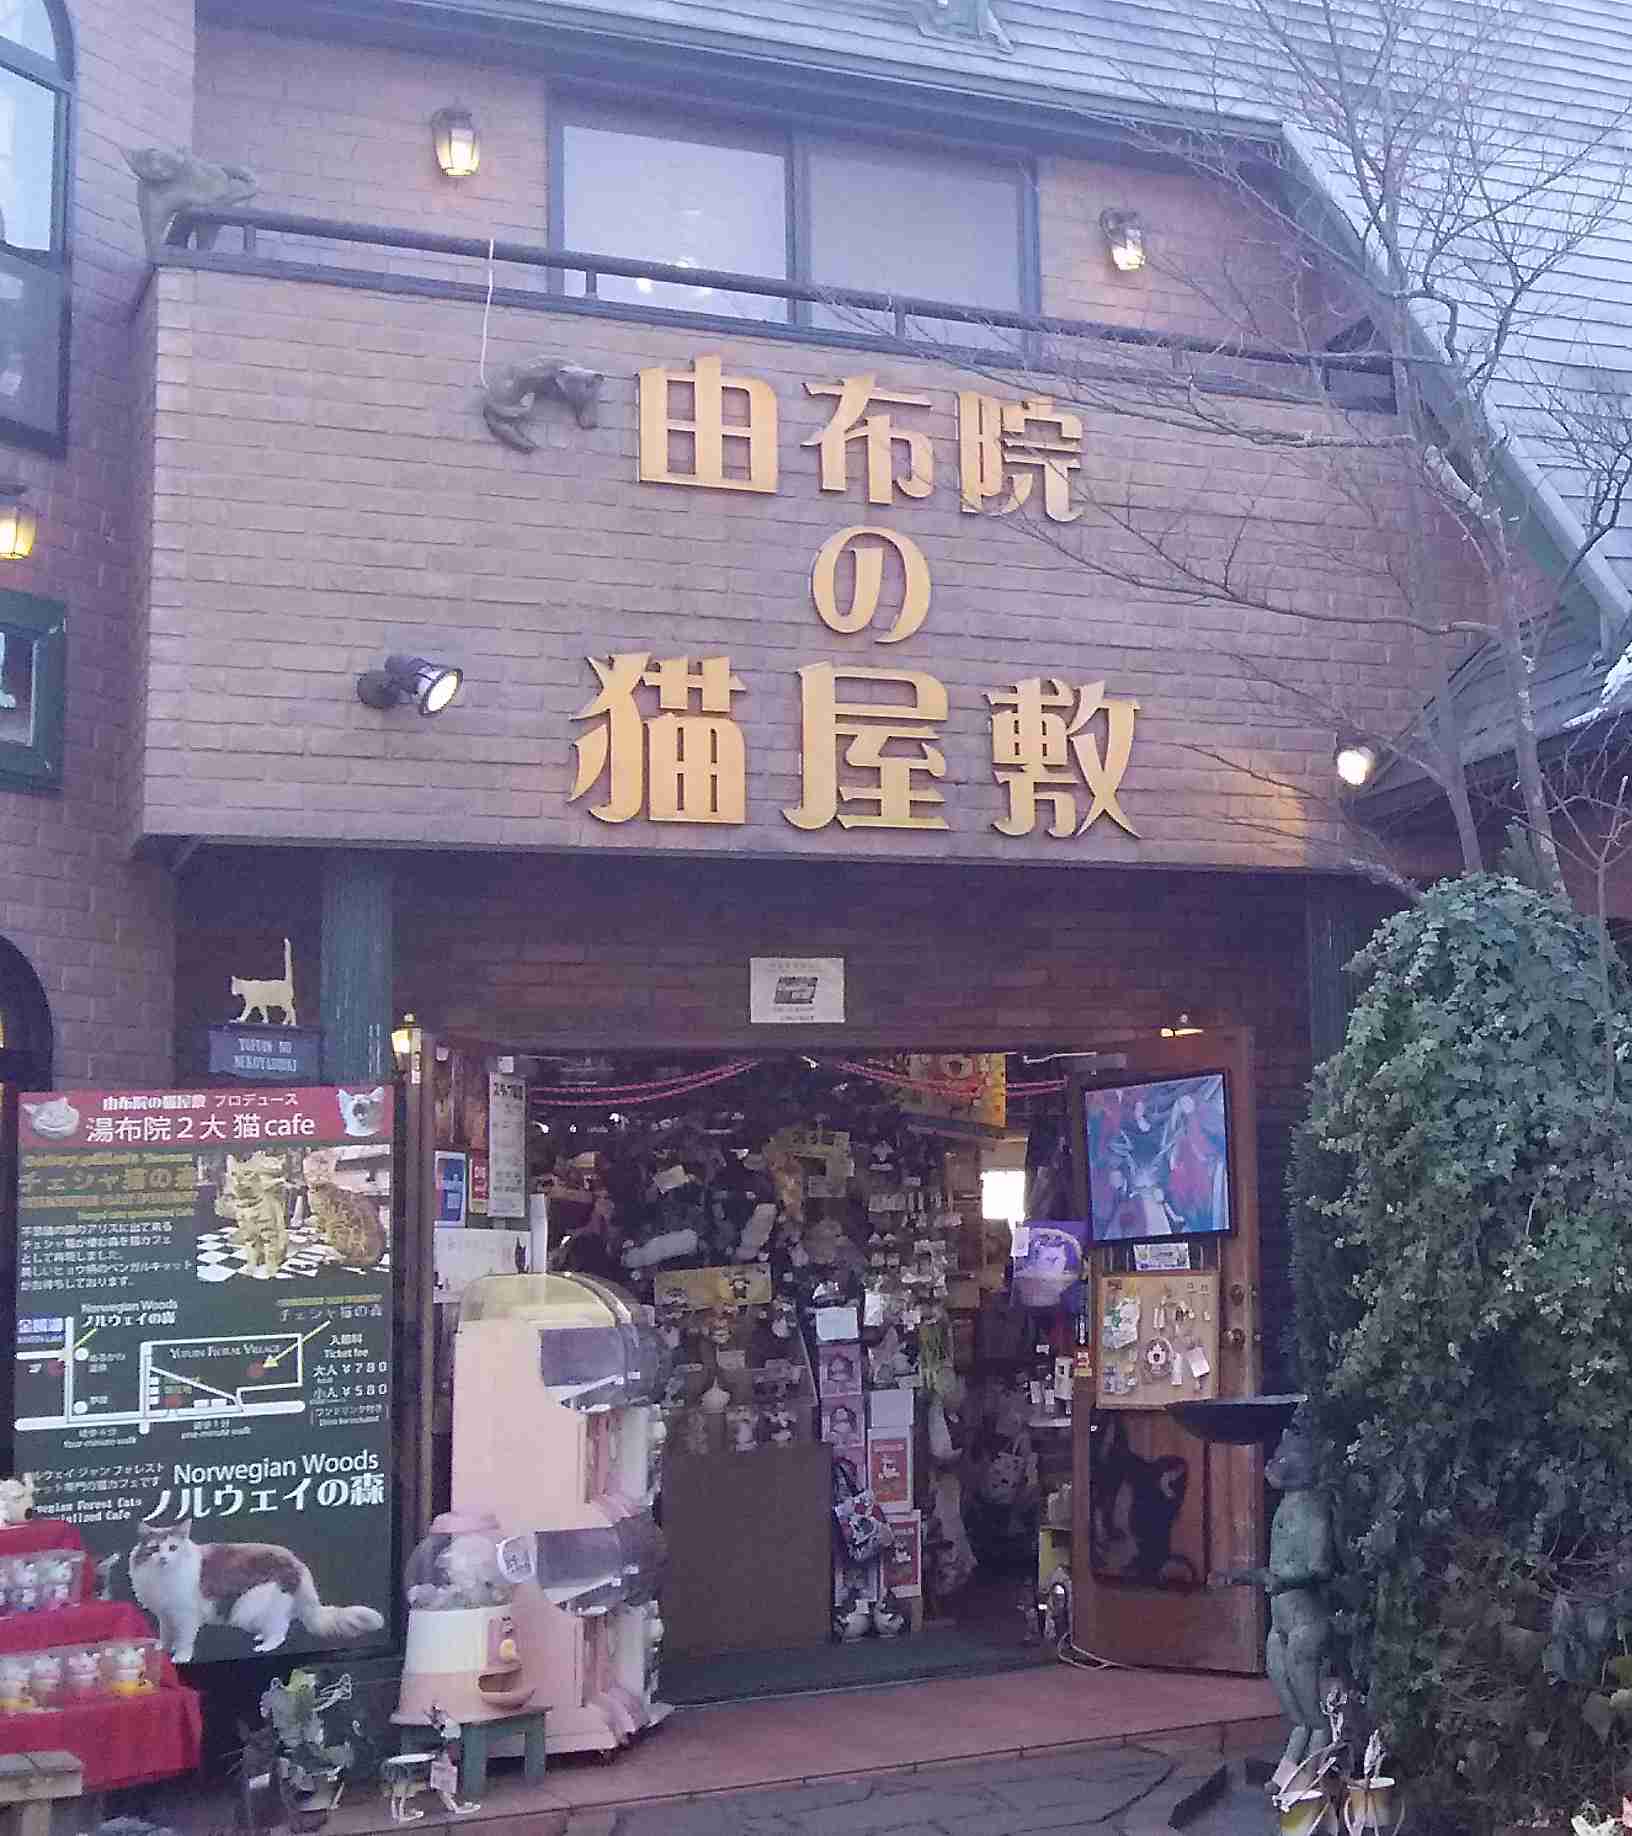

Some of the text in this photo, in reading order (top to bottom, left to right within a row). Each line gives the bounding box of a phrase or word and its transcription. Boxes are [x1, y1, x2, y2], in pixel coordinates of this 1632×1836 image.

[637, 354, 1084, 522] 由布院
[808, 524, 932, 644] の
[567, 650, 1143, 839] 猫屋敷
[143, 1472, 385, 1521] ノルウェイの森
[174, 1449, 379, 1485] Norwegian Woods
